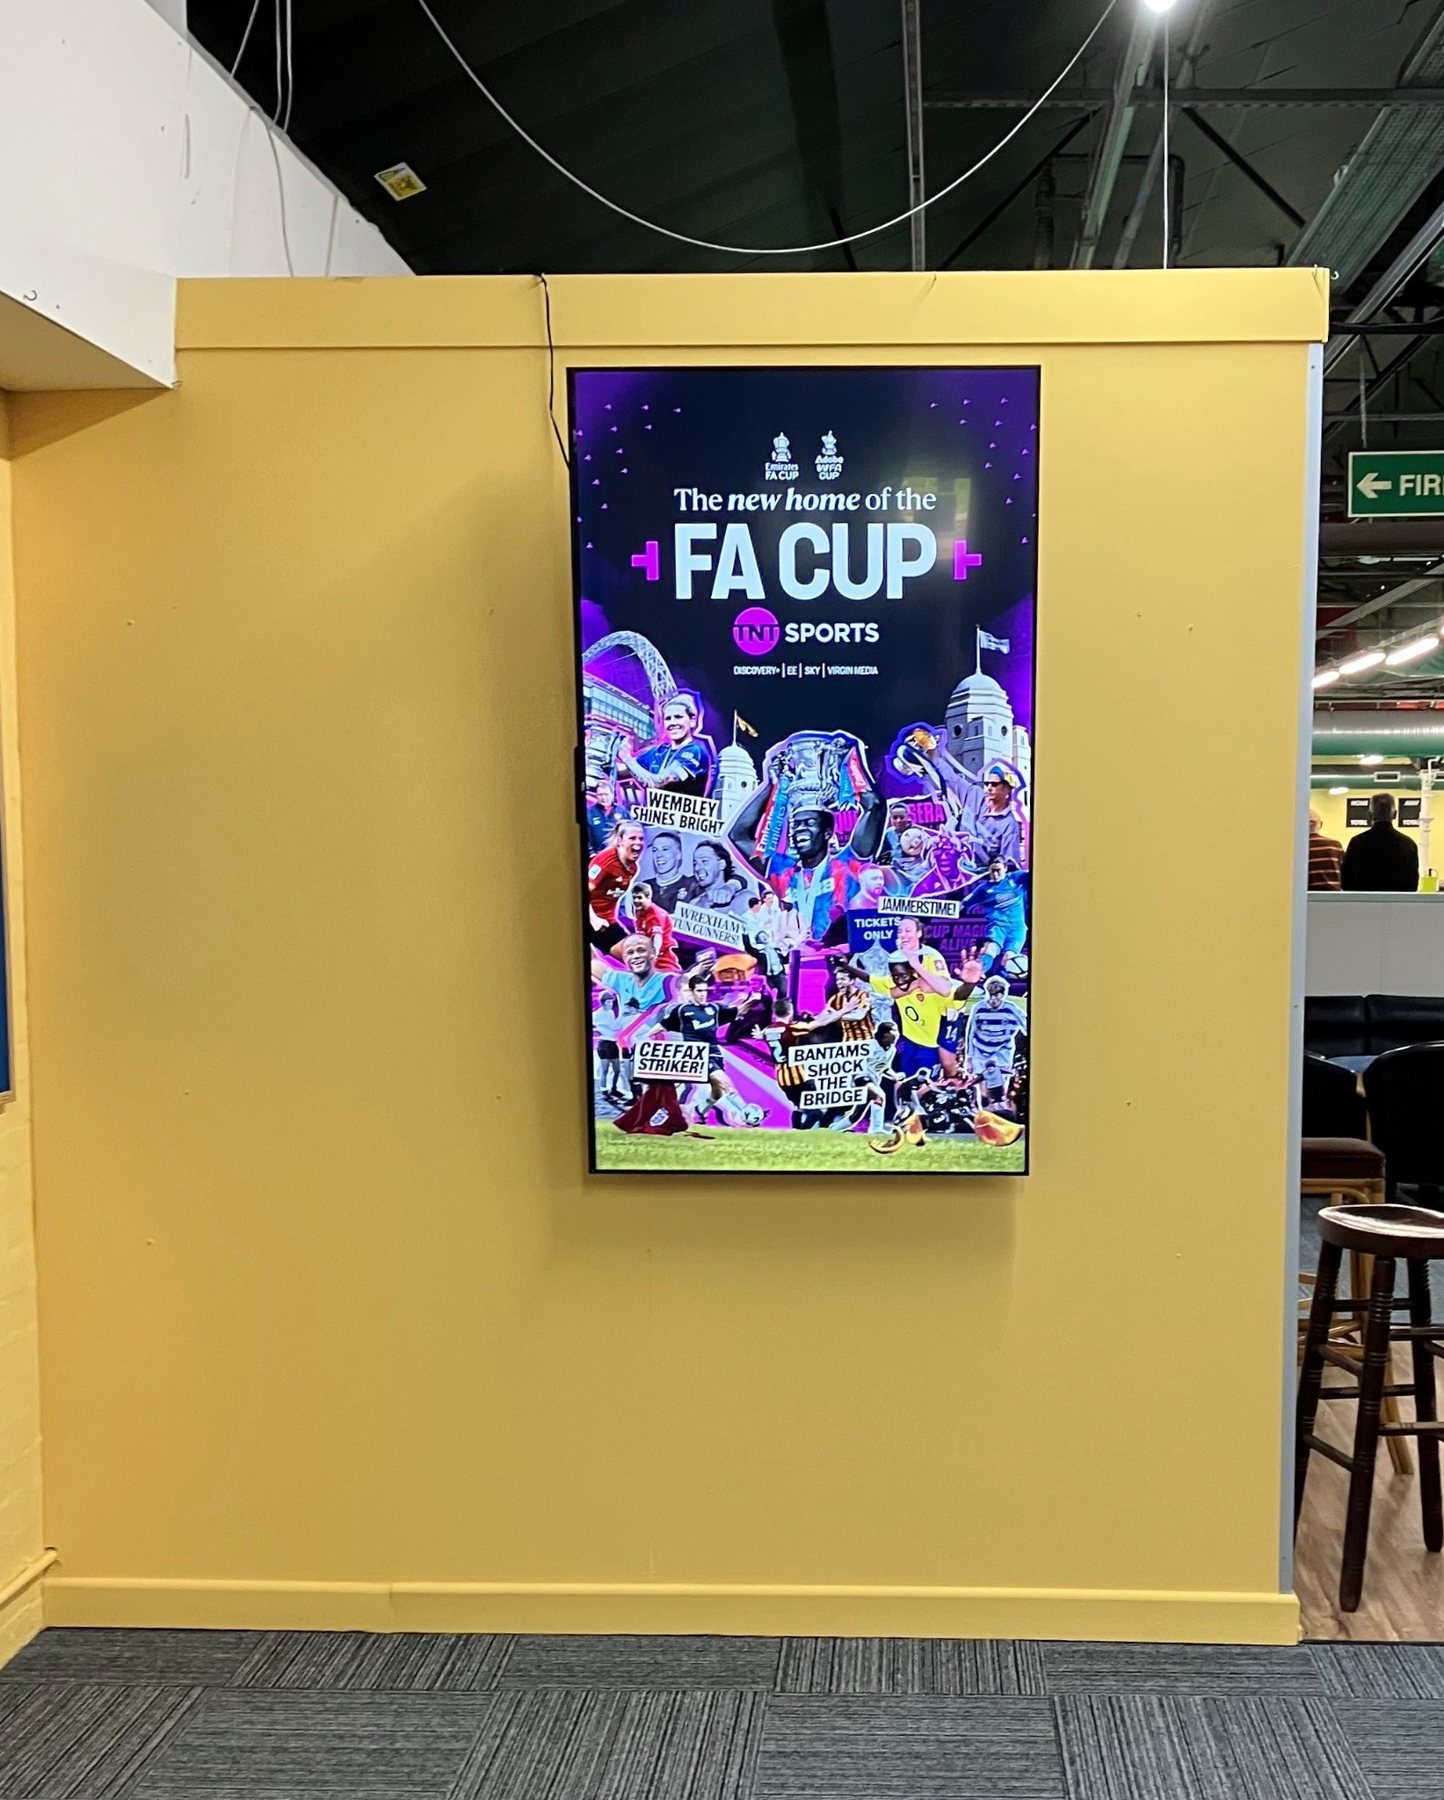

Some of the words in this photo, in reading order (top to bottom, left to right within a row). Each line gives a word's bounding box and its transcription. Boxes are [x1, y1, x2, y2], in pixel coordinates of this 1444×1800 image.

[765, 471, 778, 480] FA
[778, 471, 799, 480] CUP
[819, 472, 840, 480] CUP
[1399, 474, 1444, 496] FIR
[673, 488, 723, 511] The
[727, 493, 782, 511] new
[785, 487, 861, 511] home
[865, 487, 892, 510] of
[895, 487, 937, 510] the
[674, 523, 766, 600] FA
[779, 522, 937, 600] CUP
[733, 624, 780, 642] TNT
[784, 622, 880, 643] SPORTS
[786, 666, 798, 676] EE
[804, 666, 821, 676] SKY
[827, 666, 853, 675] VIRGIN
[854, 666, 879, 675] MEDIA
[649, 791, 717, 817] WEMBLEY
[633, 807, 675, 826] SHINES
[680, 815, 725, 834] BRIGHT
[881, 898, 957, 916] JAMMERSTIME!
[681, 907, 740, 933] WREXHAM
[854, 916, 901, 928] TICKETS
[863, 930, 894, 941] ONLY
[639, 1042, 706, 1060] CEEFAX
[794, 1043, 870, 1062] BANTAMS
[638, 1058, 705, 1074] STRIKER!
[808, 1059, 863, 1077] SHOCK
[817, 1076, 848, 1090] THE
[803, 1089, 863, 1106] BRIDGE
